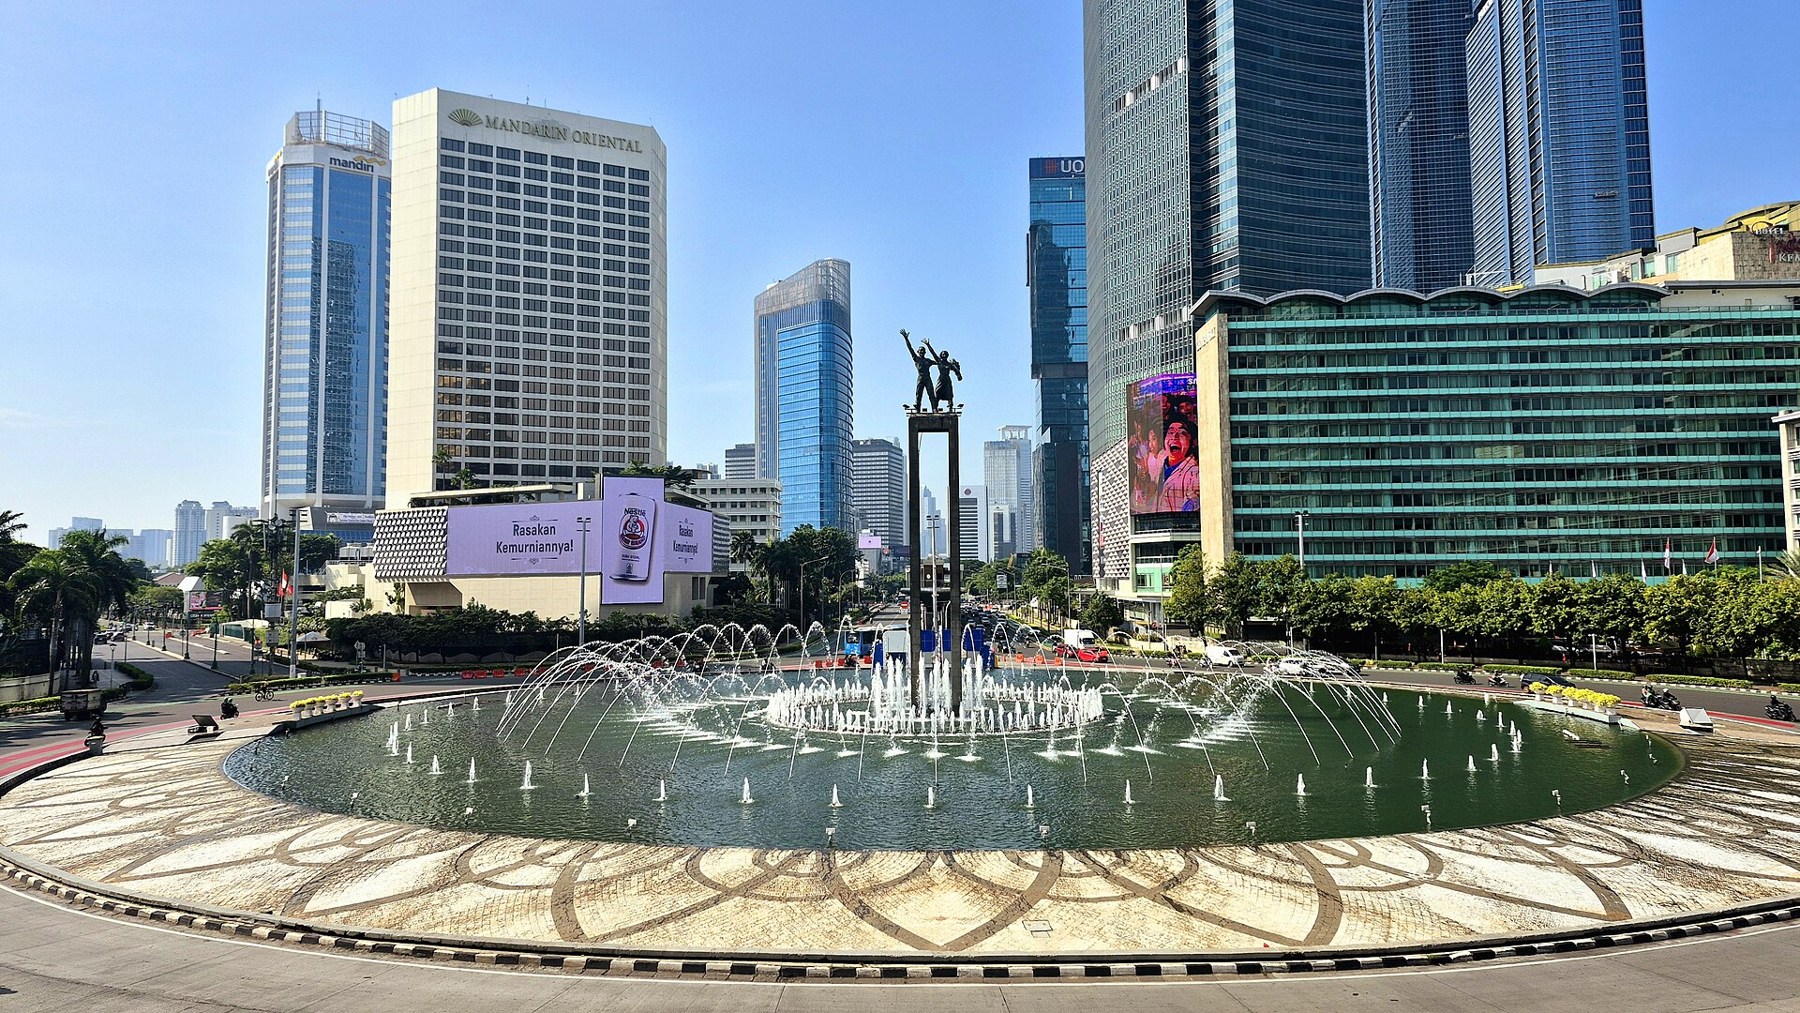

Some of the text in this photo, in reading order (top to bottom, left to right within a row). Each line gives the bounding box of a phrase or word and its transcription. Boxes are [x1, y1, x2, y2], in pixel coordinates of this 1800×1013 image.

[485, 115, 643, 153] MANDARIN ORIENTAL
[329, 157, 374, 172] mandiri
[1756, 227, 1786, 235] HOTEL
[513, 523, 556, 536] Rasakan
[496, 539, 574, 555] Kemurniannya!
